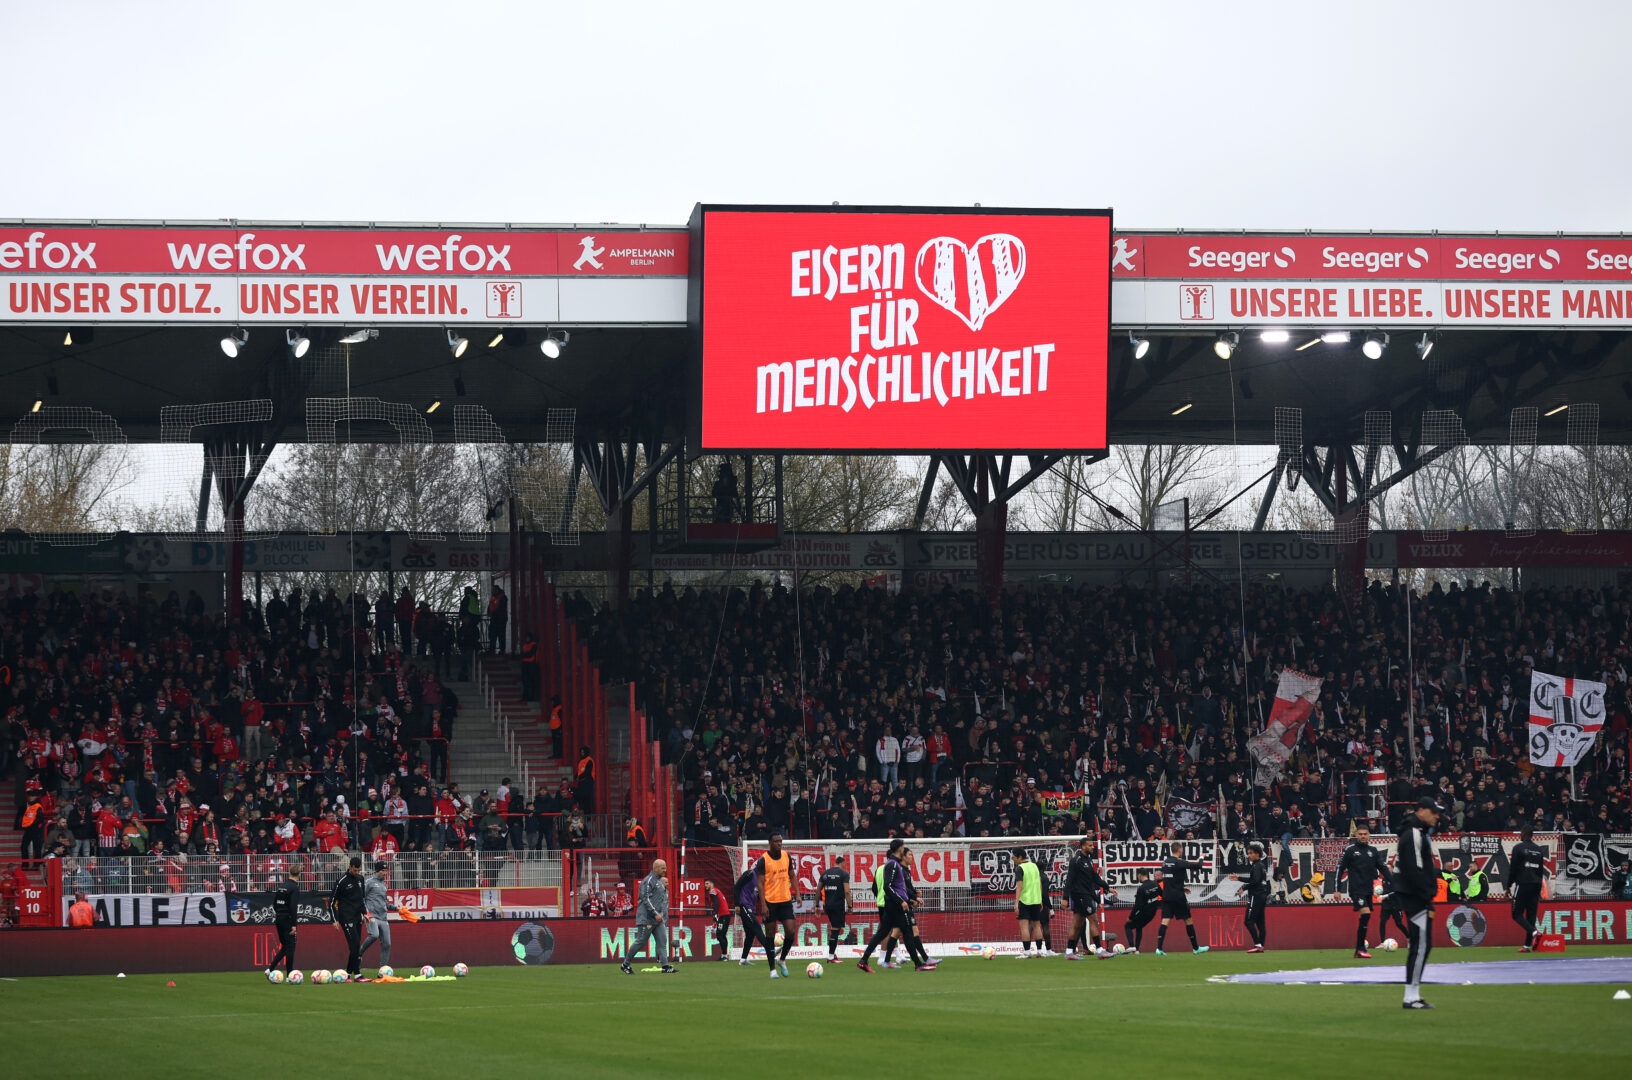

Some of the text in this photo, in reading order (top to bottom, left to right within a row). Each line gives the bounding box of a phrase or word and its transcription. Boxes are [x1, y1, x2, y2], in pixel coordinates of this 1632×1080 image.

[167, 233, 305, 271] wefox
[375, 234, 511, 272] wefox
[609, 248, 675, 257] AMPELMANN
[1188, 246, 1271, 272] Seeger
[1322, 247, 1404, 273] Seeger
[1455, 247, 1536, 274] Seeger
[1586, 248, 1632, 275] See
[9, 282, 468, 315] UNSER STOLZ. UNSER VEREIN.
[1230, 288, 1338, 318] UNSERE
[1348, 289, 1433, 318] LIEBE.
[1444, 289, 1551, 319] UNSERE
[849, 291, 919, 354] FÜR
[263, 540, 326, 552] FAMILIEN
[1240, 539, 1384, 562] GERÜSTU
[1409, 544, 1464, 557] VELUX
[263, 554, 310, 566] BLOCK
[25, 889, 41, 899] Tor
[684, 880, 700, 891] Tor
[27, 903, 40, 914] 10
[687, 895, 700, 905] 12
